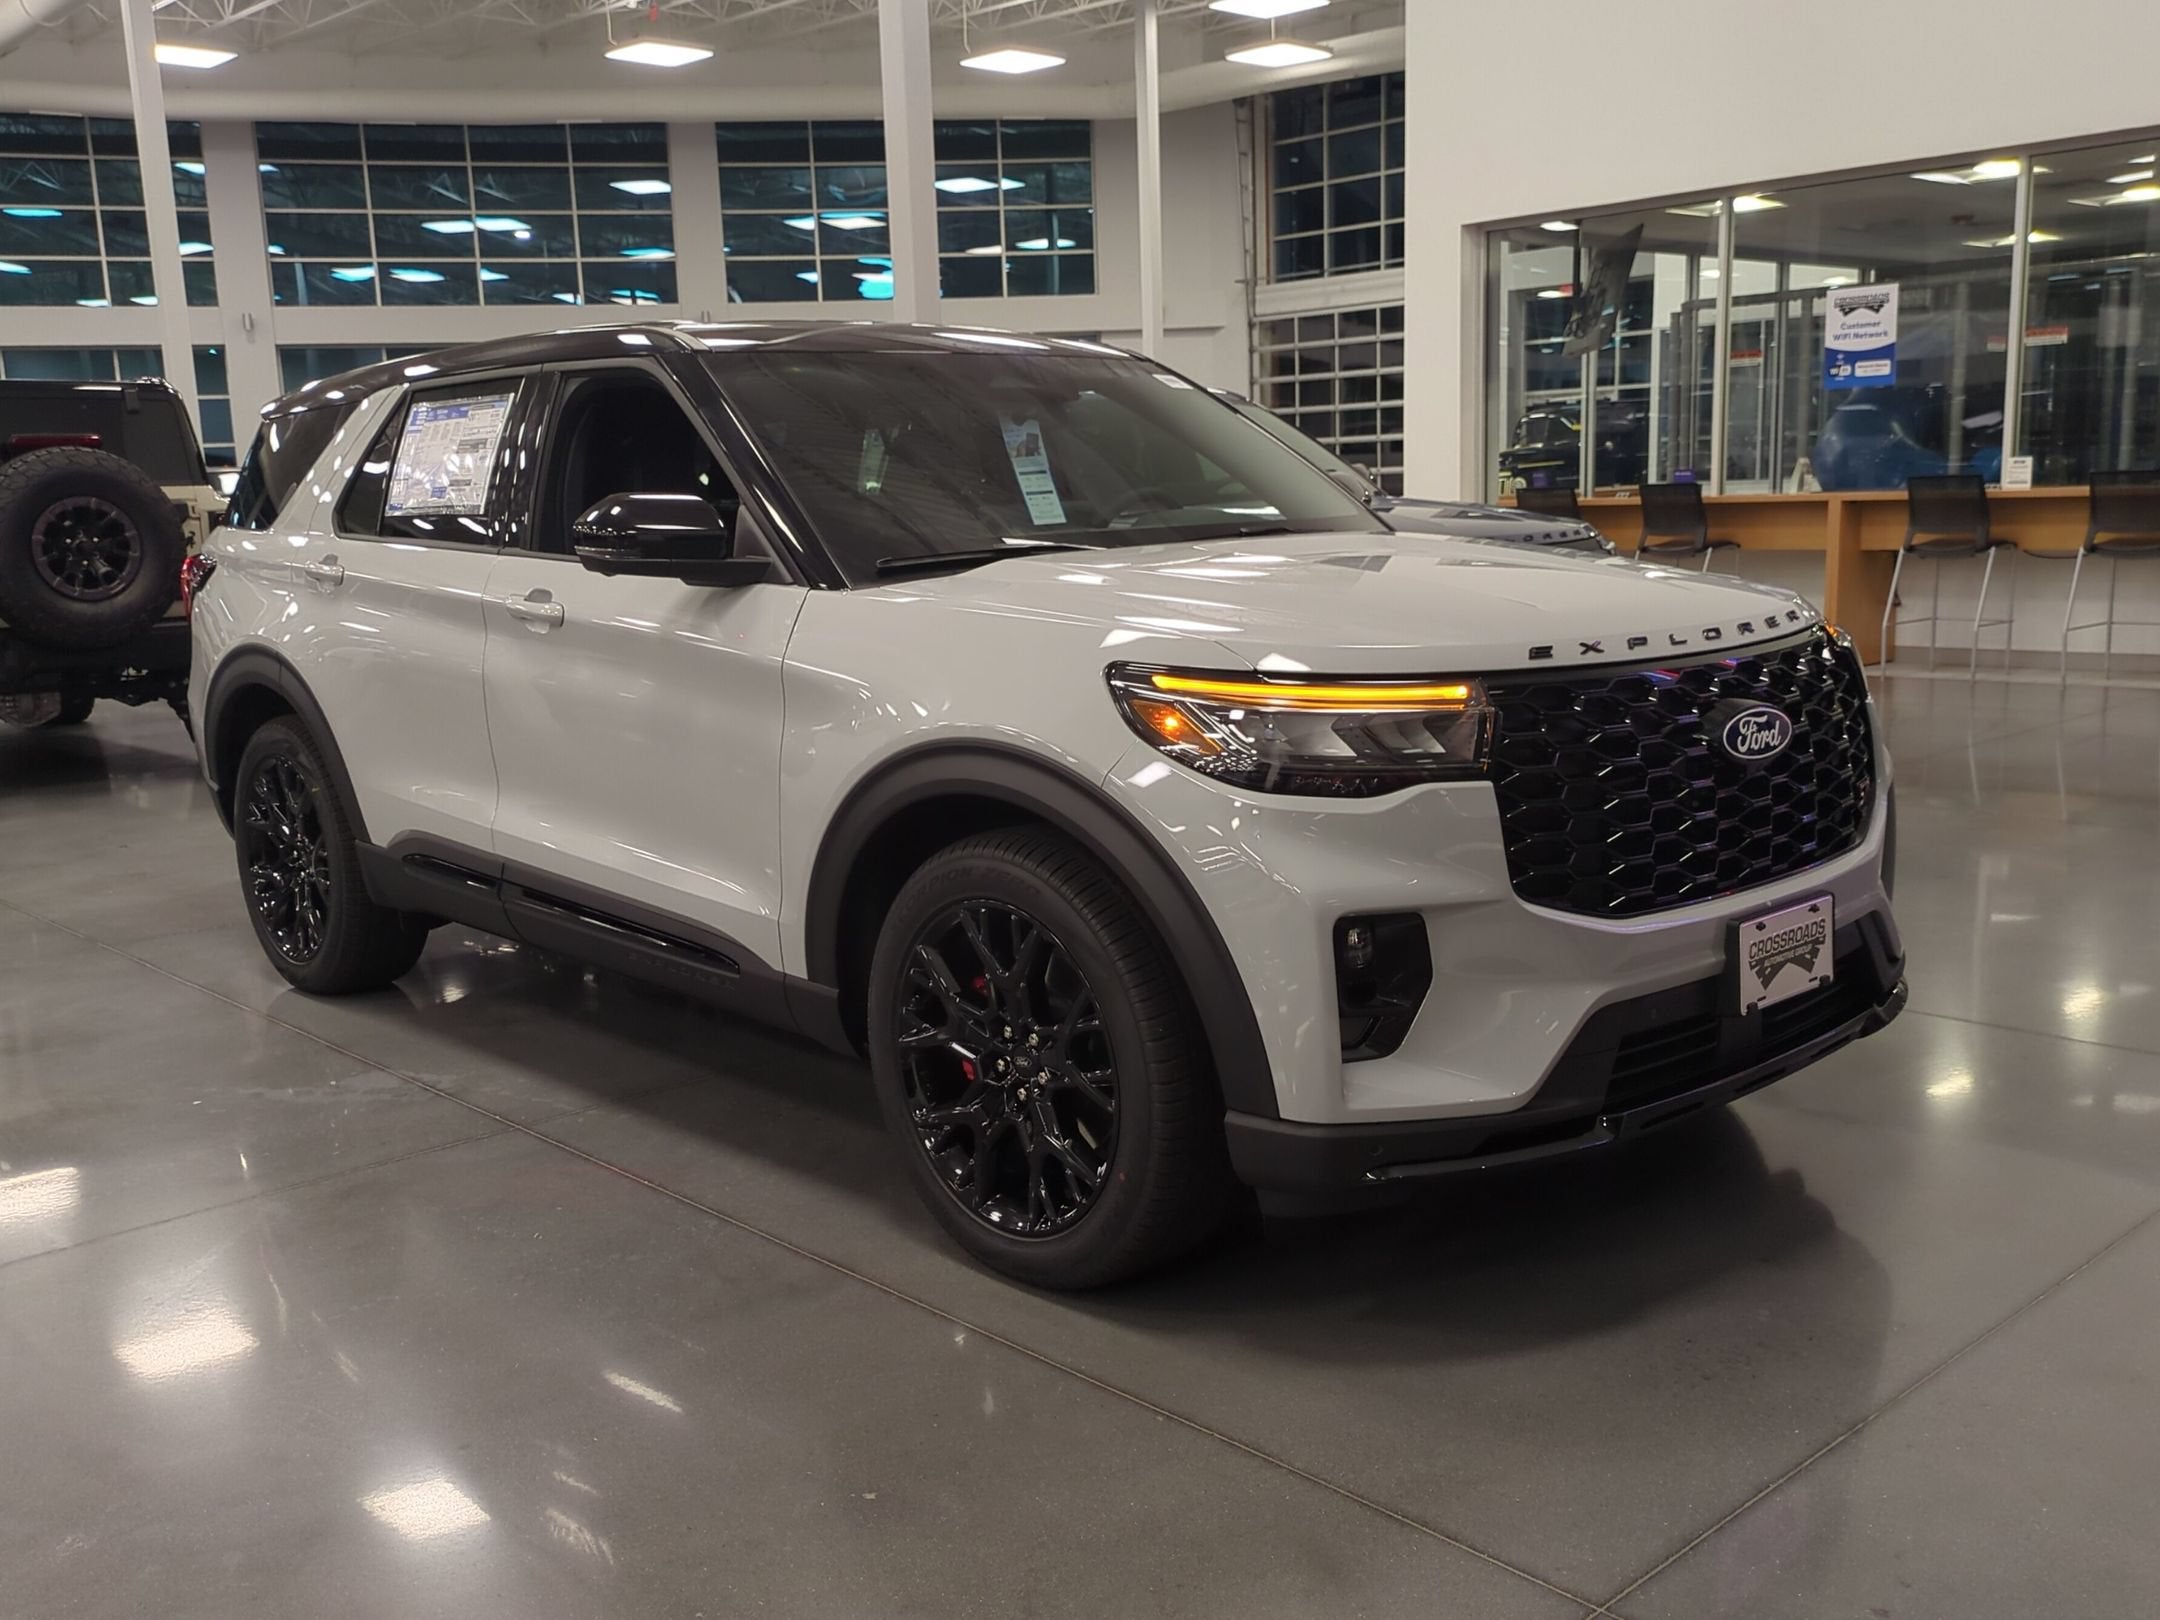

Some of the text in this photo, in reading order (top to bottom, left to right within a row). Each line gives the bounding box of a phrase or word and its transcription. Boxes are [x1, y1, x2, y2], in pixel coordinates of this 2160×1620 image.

[1840, 321, 1881, 330] Customer
[1853, 331, 1889, 340] Network
[1528, 609, 1801, 661] EXPLORER
[1737, 714, 1782, 753] Ford
[1748, 918, 1826, 960] CROSSROADS
